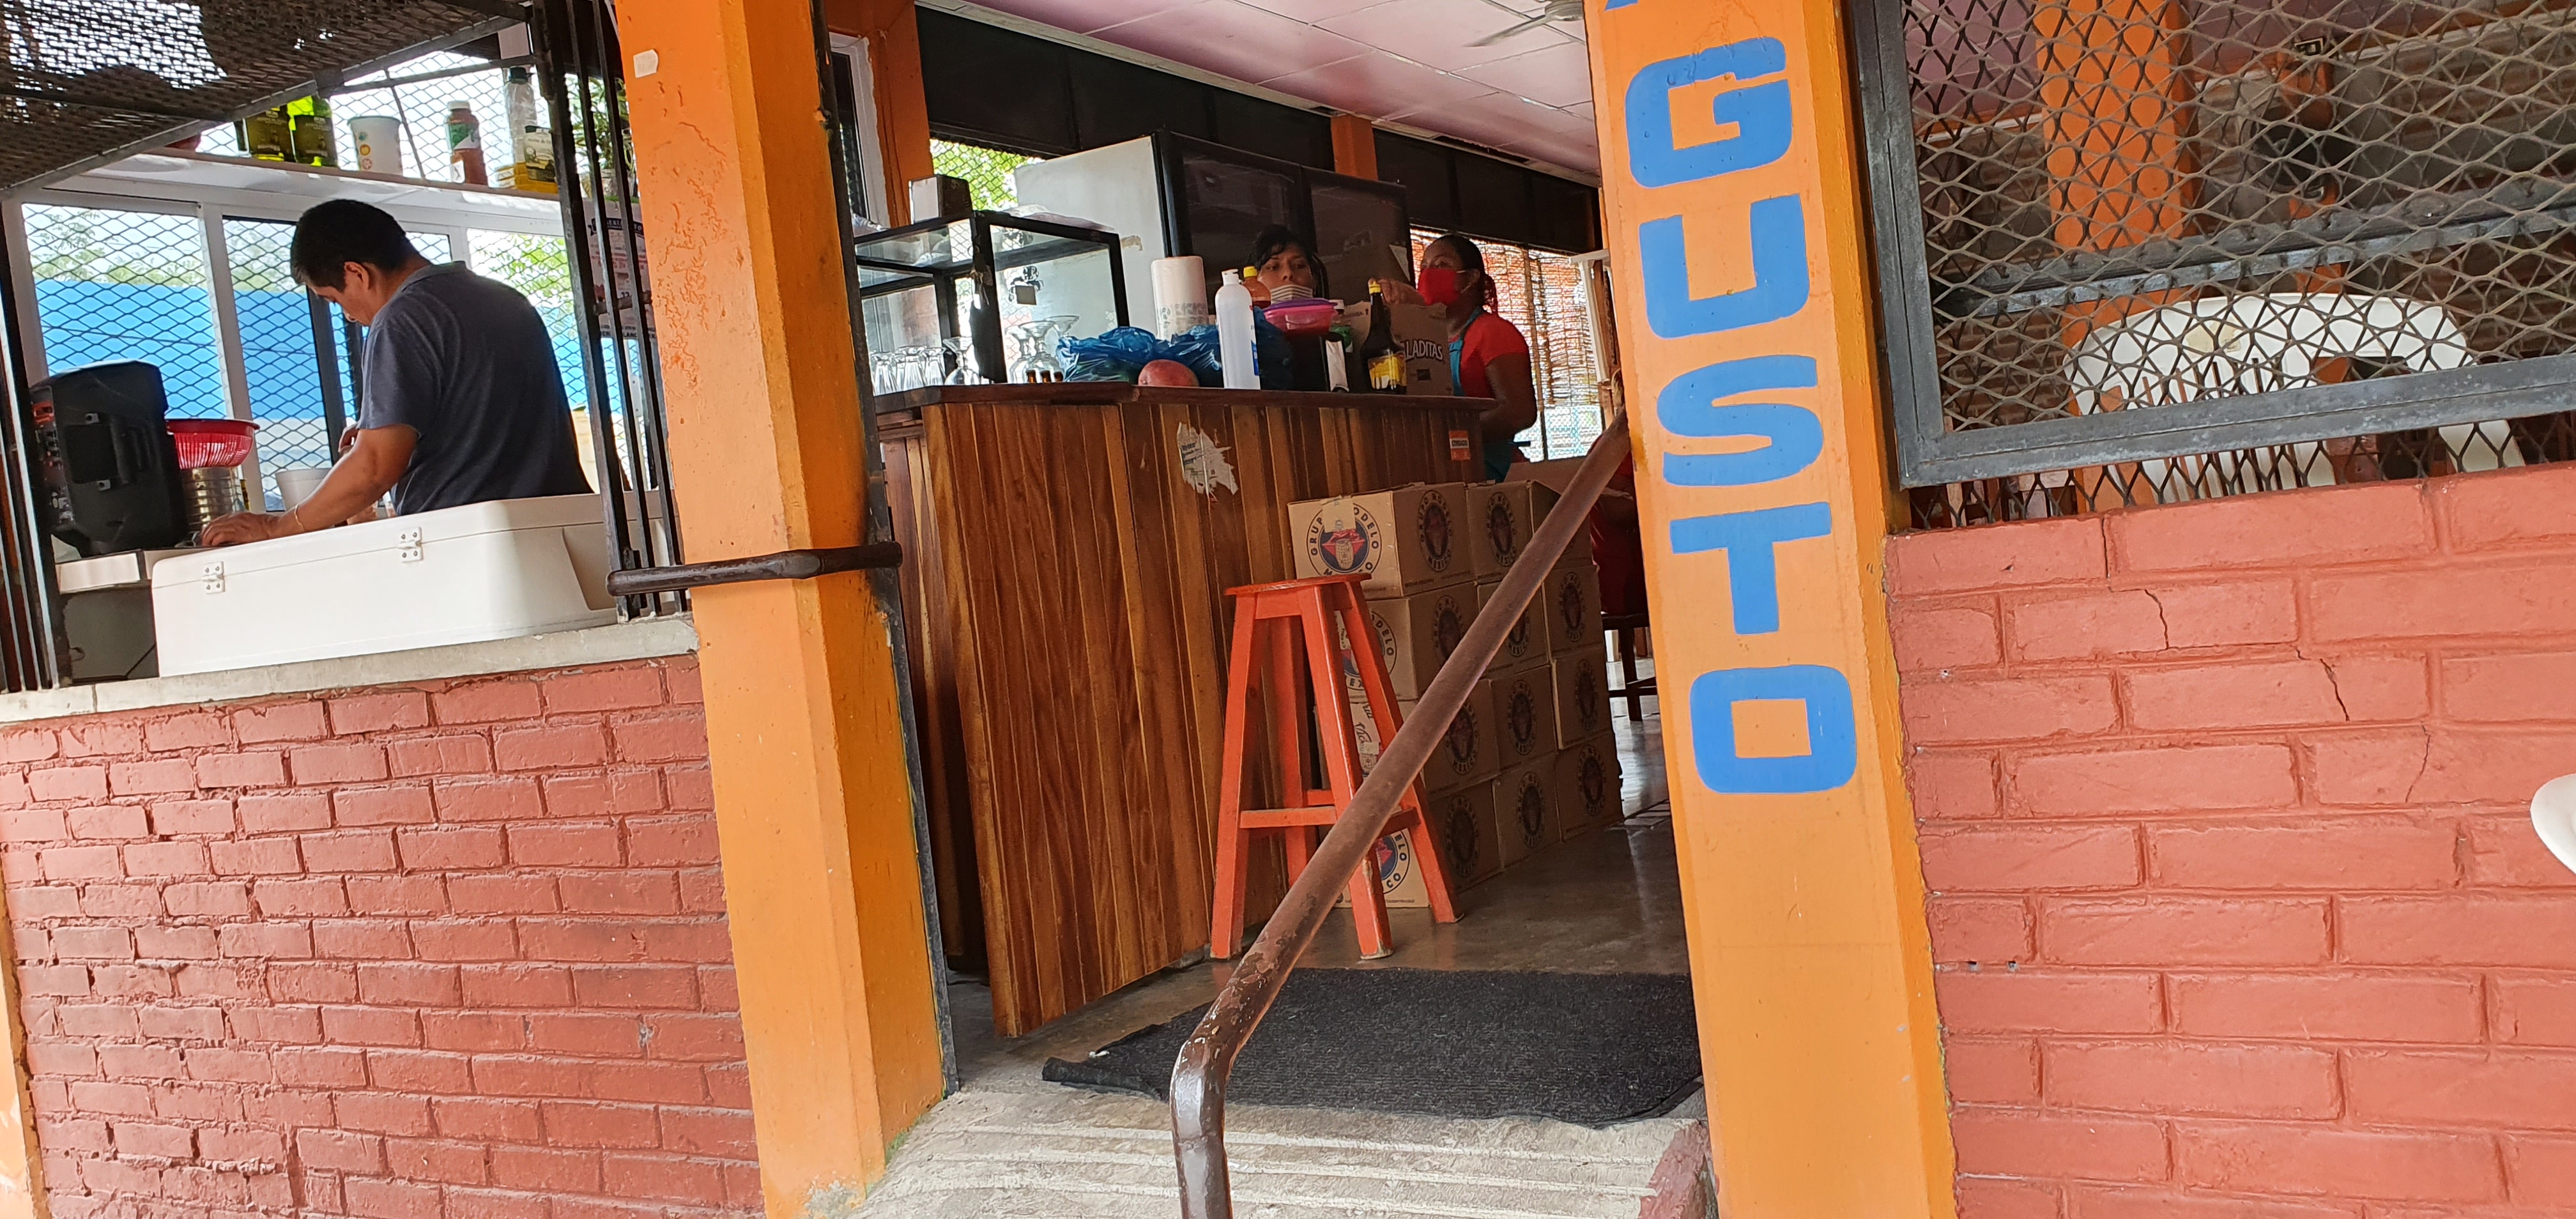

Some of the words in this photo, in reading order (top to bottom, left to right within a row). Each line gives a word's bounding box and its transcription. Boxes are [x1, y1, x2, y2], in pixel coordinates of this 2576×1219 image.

[1405, 340, 1444, 361] LADITAS
[1625, 36, 1857, 794] GUSTO
[1309, 517, 1324, 556] GRUP
[1354, 507, 1379, 549] ODELO
[1372, 614, 1394, 656] DELO
[1395, 834, 1407, 861] ELO
